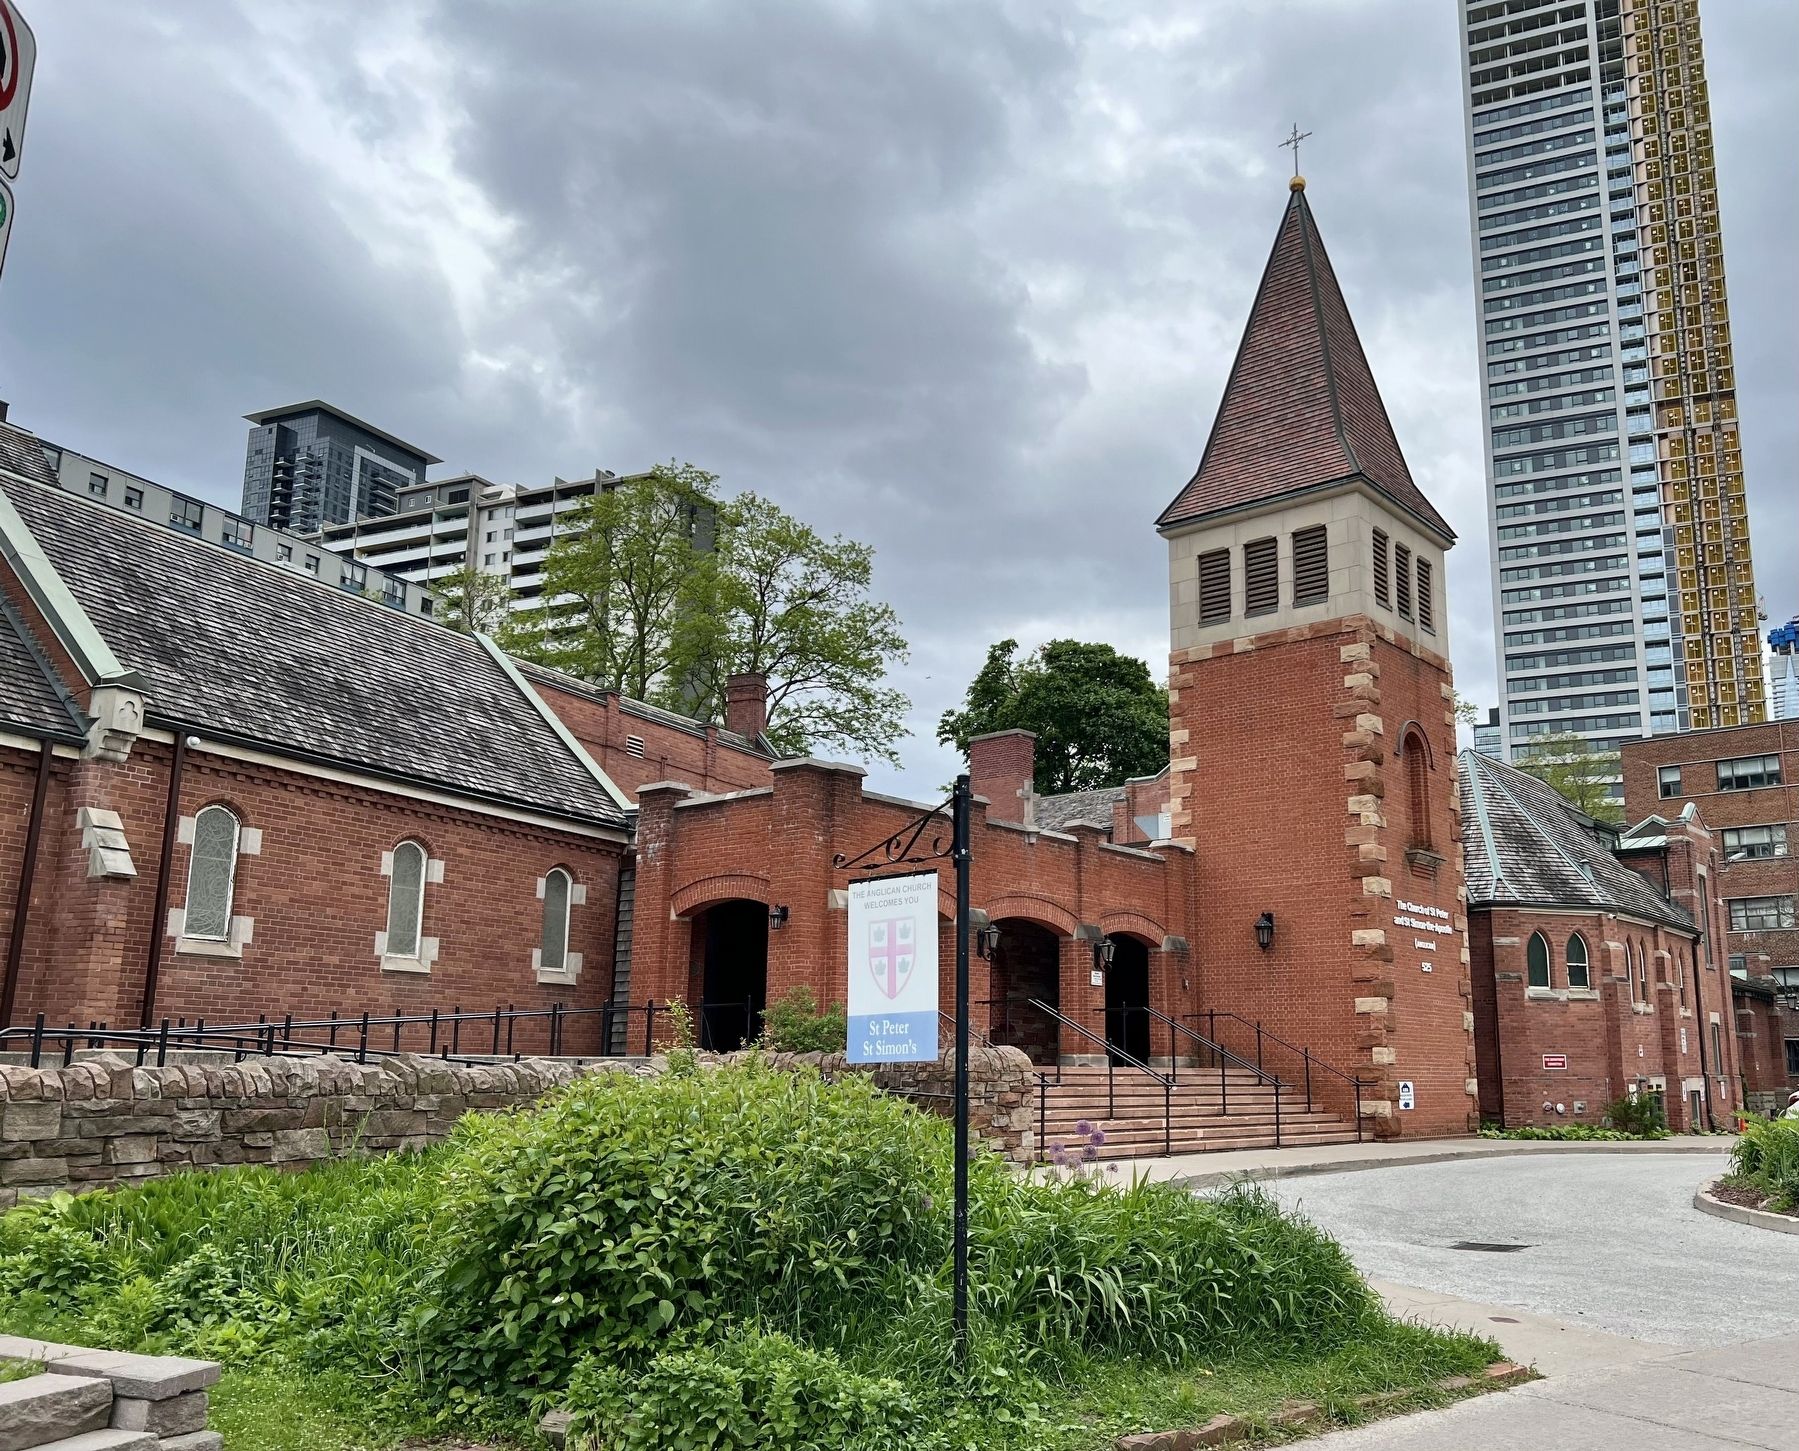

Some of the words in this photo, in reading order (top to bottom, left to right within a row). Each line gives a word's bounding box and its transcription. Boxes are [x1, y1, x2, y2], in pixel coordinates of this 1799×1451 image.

[852, 890, 865, 899] THE
[866, 886, 900, 897] ANGLICAN
[902, 882, 932, 893] CHURCH
[864, 898, 902, 909] WELCOMES
[904, 896, 919, 904] YOU
[869, 1020, 880, 1036] St
[882, 1020, 910, 1035] Peter
[863, 1040, 873, 1056] St
[876, 1039, 917, 1056] Simon's
